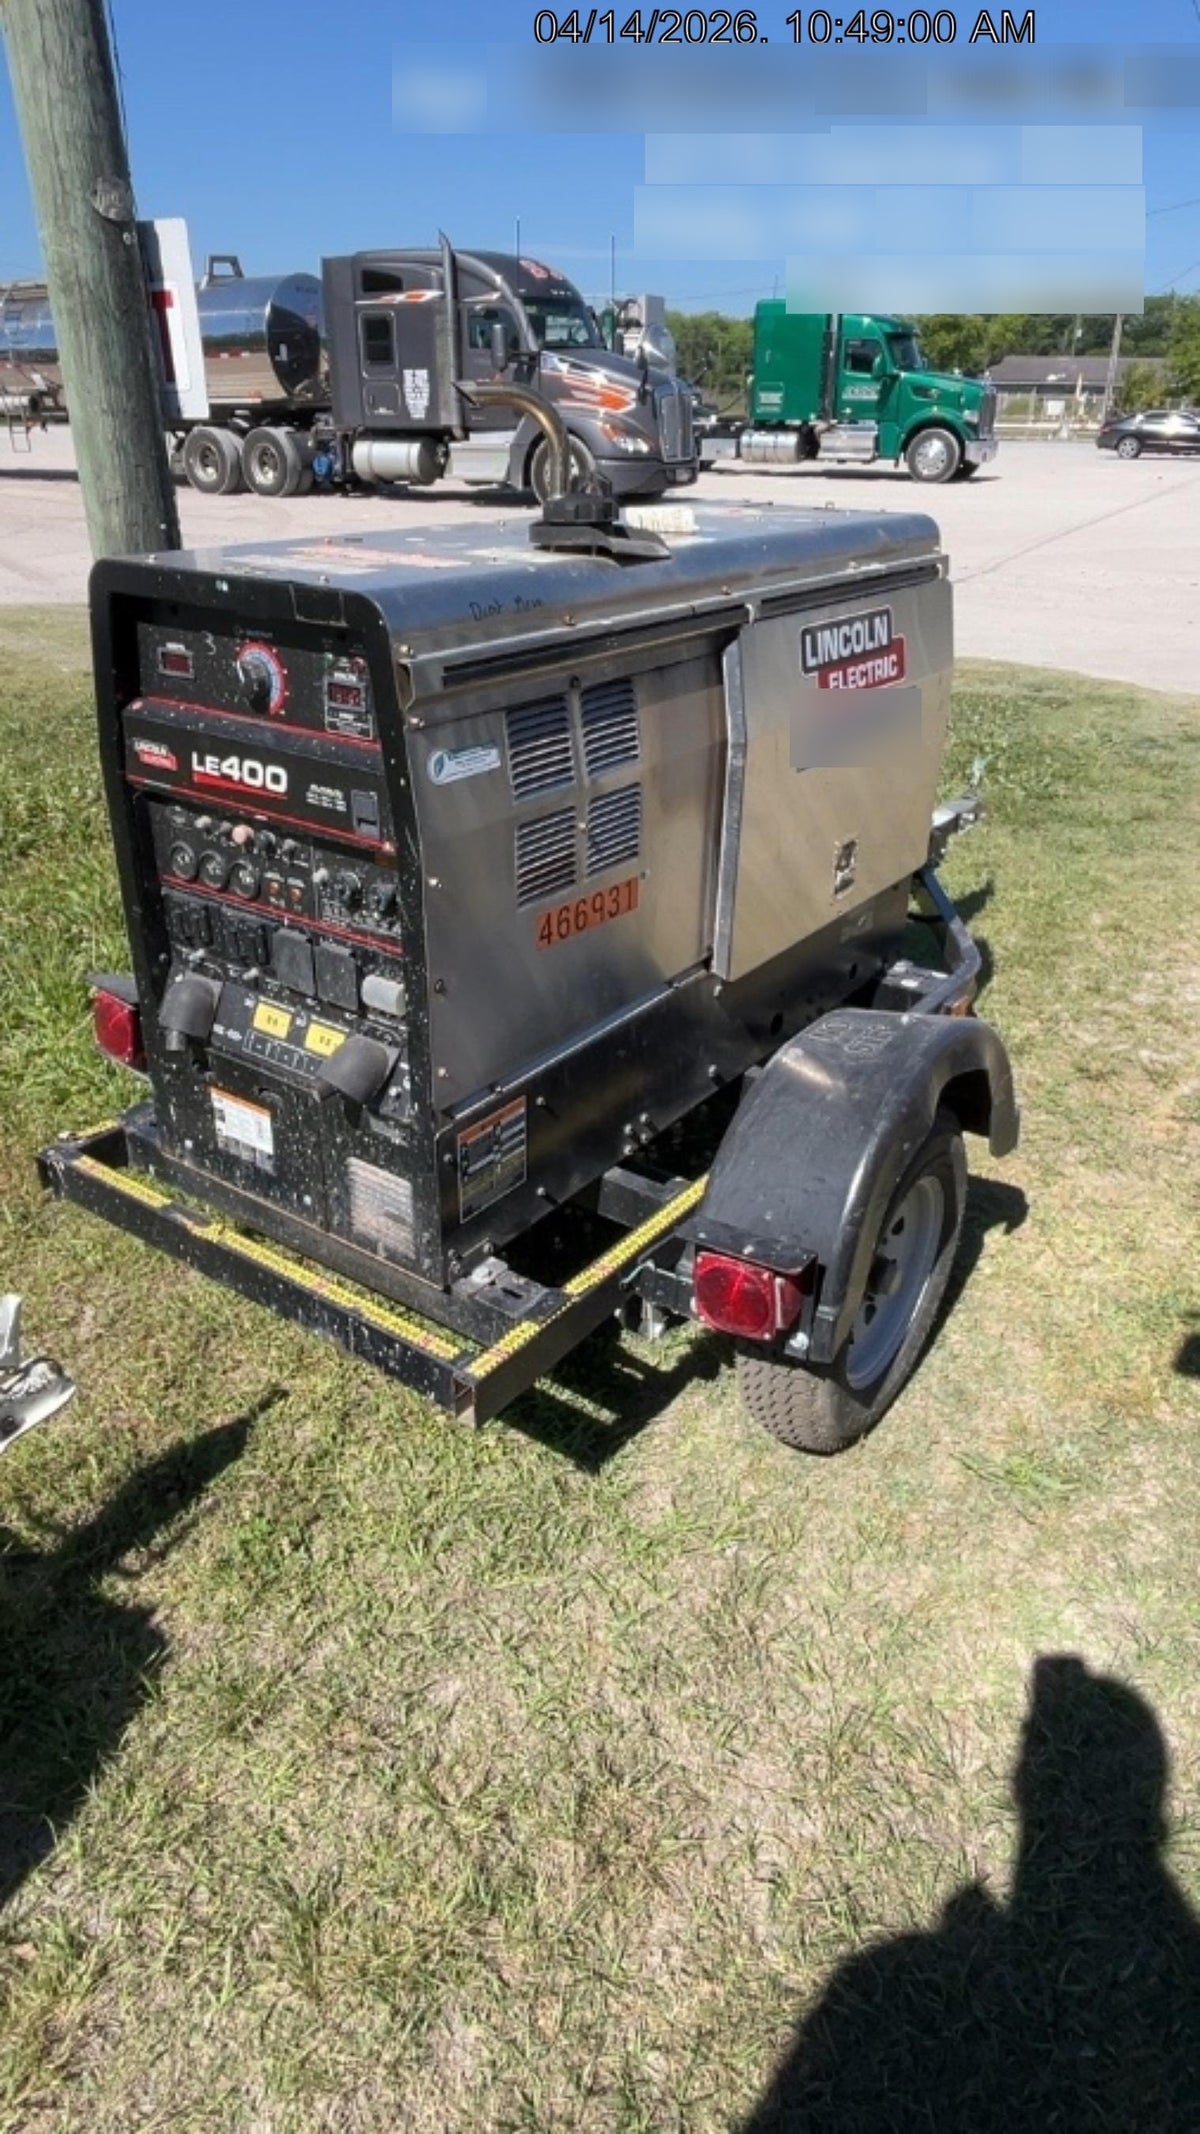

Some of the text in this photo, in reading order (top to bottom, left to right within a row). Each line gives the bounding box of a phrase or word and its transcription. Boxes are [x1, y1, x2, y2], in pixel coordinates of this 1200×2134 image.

[805, 613, 889, 668] LINCOLN
[828, 653, 898, 689] ELECTRIC
[191, 751, 288, 794] LE400
[539, 879, 632, 945] 466931
